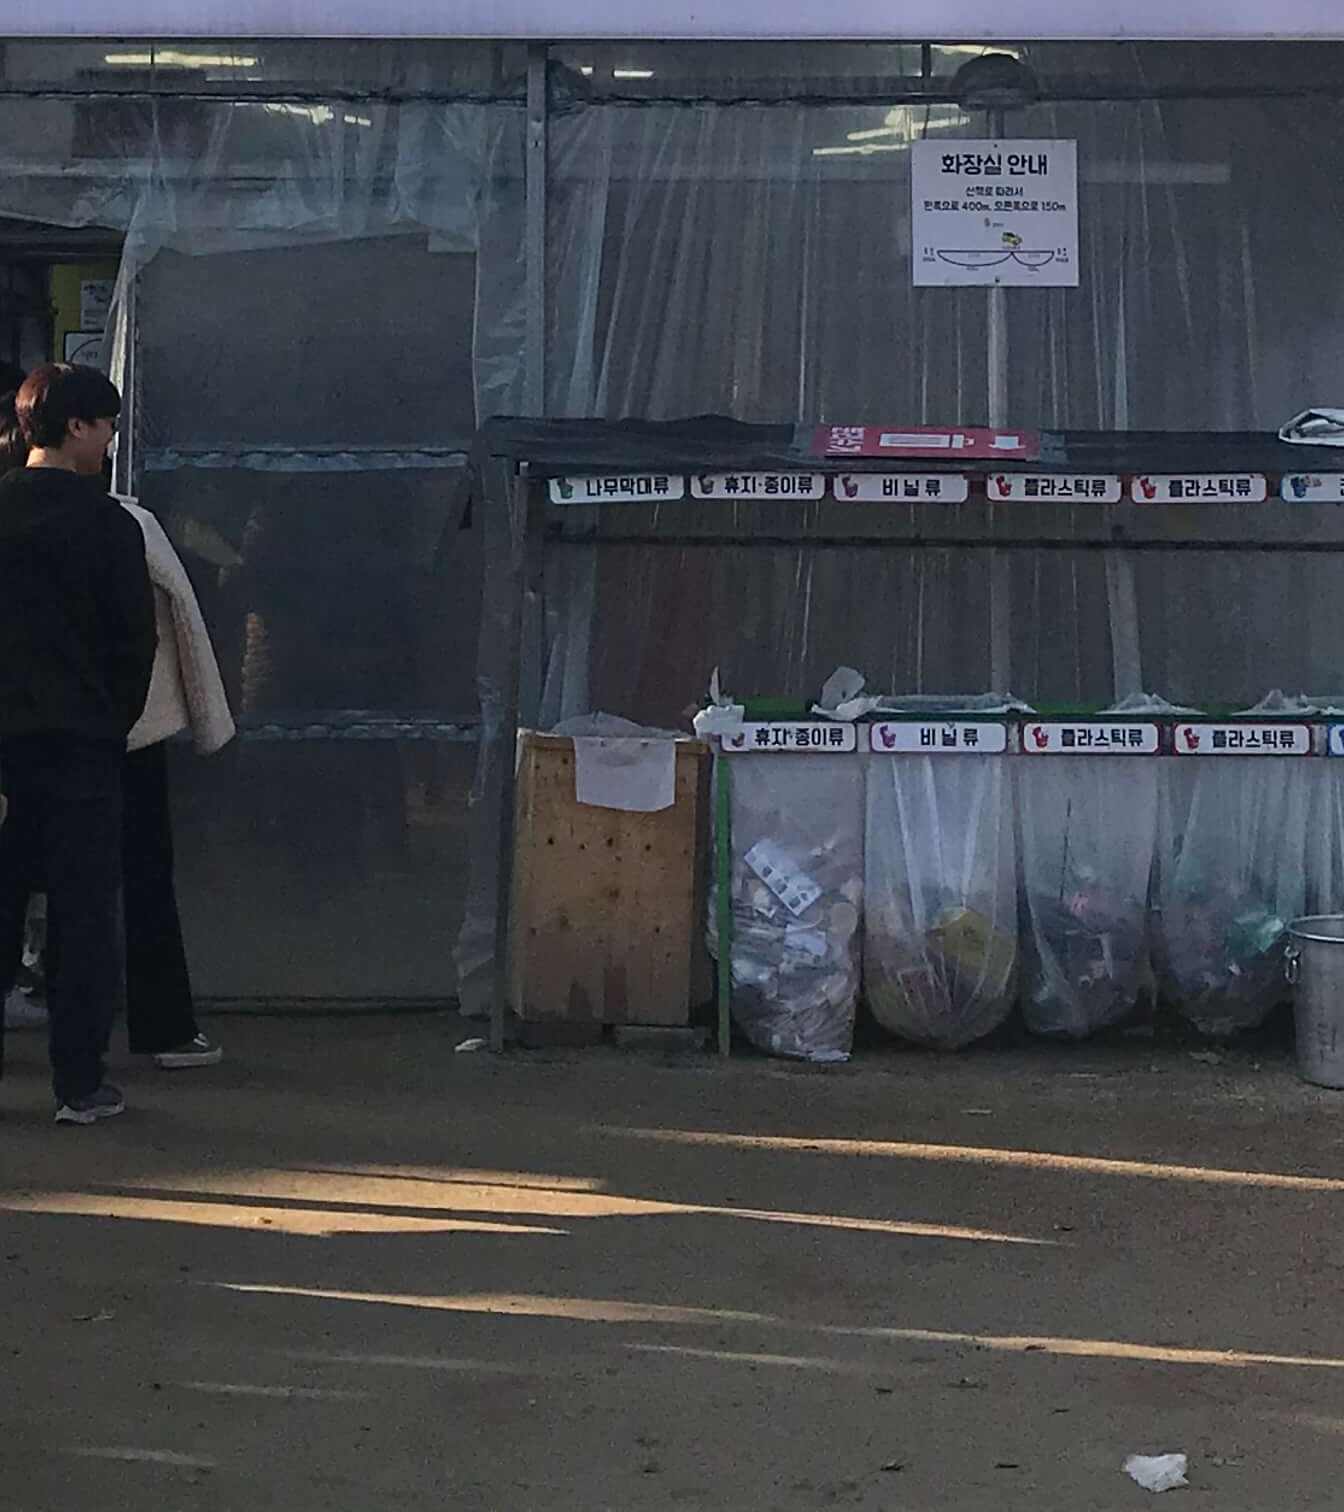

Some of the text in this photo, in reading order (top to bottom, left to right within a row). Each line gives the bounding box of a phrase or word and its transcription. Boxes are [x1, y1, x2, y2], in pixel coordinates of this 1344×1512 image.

[941, 153, 1048, 176] 화장실 안내
[586, 476, 670, 497] 나무막대류
[1024, 478, 1107, 498] 플라스틱류
[1168, 478, 1252, 498] 플라스틱류
[1061, 728, 1144, 748] 플라스틱류
[1212, 729, 1296, 749] 플라스틱류
